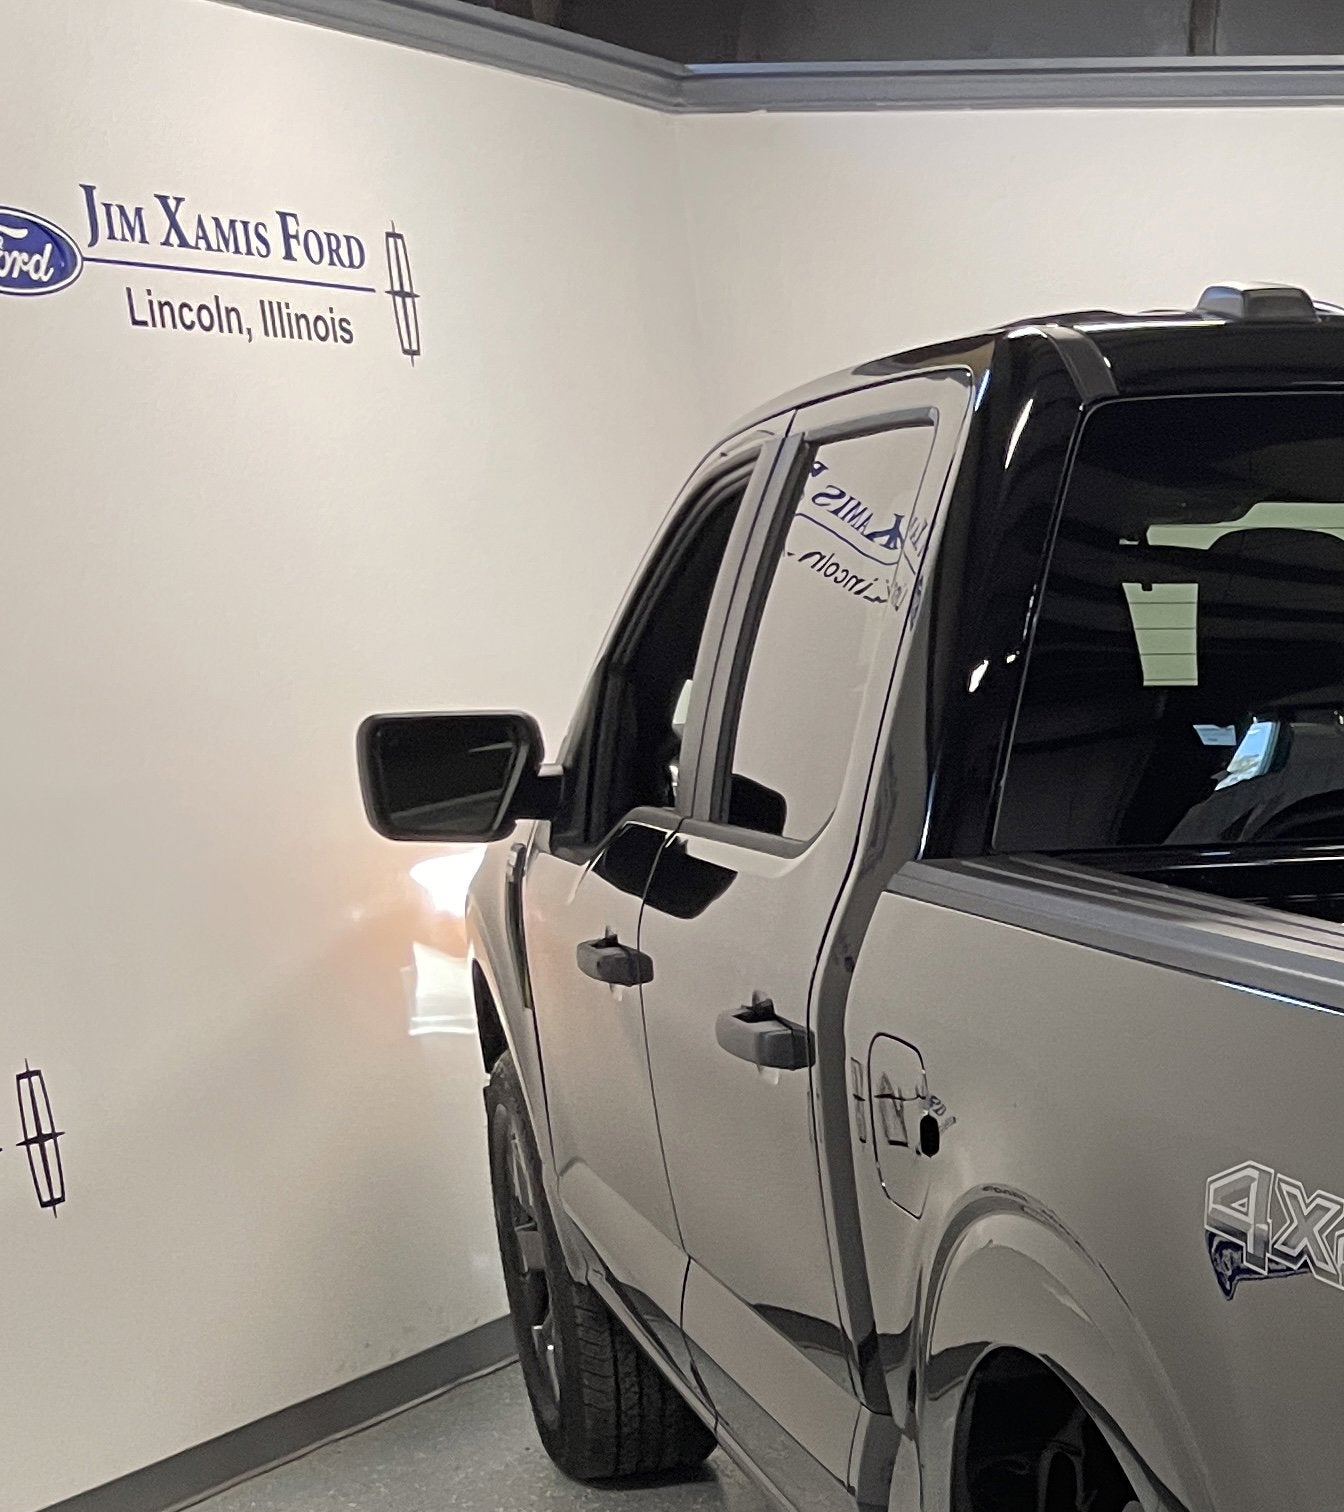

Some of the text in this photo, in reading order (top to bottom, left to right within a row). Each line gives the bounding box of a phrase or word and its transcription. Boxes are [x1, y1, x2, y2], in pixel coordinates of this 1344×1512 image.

[0, 224, 54, 281] ord
[79, 184, 366, 269] JIM XAMIS FORD
[126, 287, 354, 345] Lincoln, Illinois
